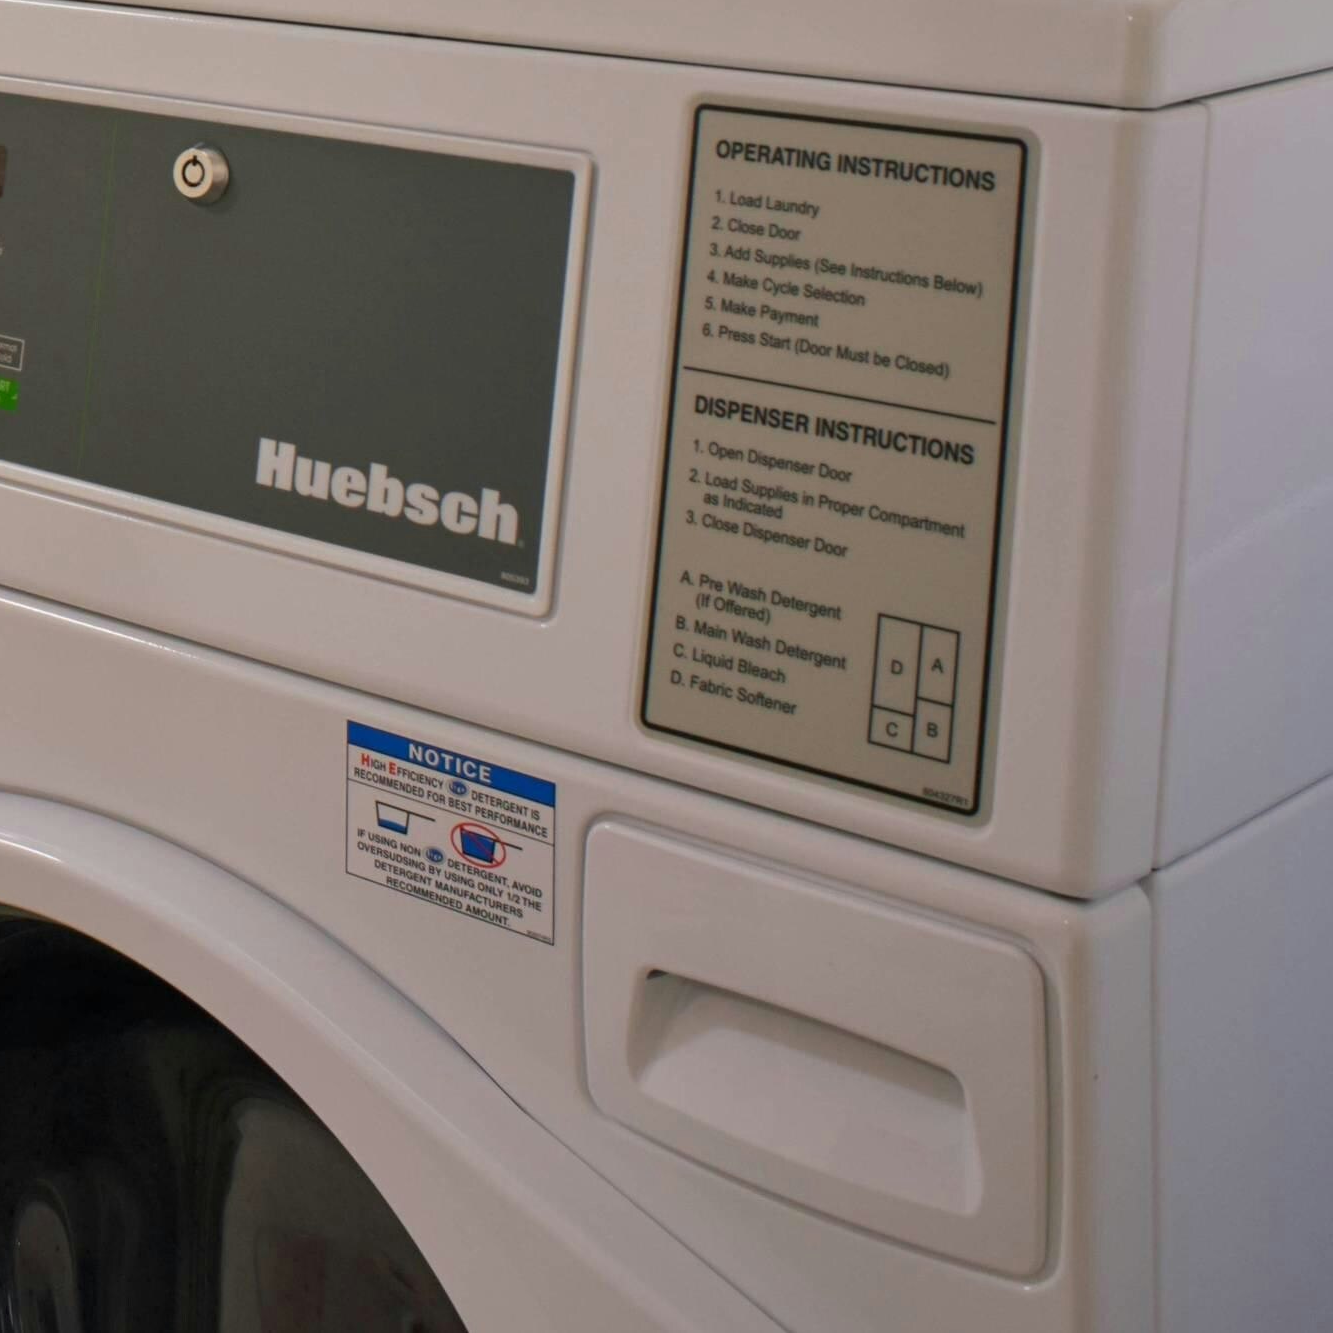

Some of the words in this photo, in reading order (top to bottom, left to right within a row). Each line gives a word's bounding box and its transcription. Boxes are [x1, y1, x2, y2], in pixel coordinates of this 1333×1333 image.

[716, 139, 831, 171] OPERATING
[837, 154, 995, 192] INSTRUCTIONS
[715, 189, 725, 203] 1.
[730, 191, 763, 209] Load
[765, 196, 820, 219] Laundry
[711, 215, 723, 230] 2.
[727, 218, 765, 236] Close
[768, 223, 801, 241] Door
[707, 269, 718, 283] 4.
[723, 271, 759, 290] Make
[762, 277, 800, 297] Cycle
[803, 283, 865, 306] Selection
[709, 242, 720, 256] 3.
[723, 245, 751, 261] Add
[754, 248, 811, 270] Supplies
[814, 258, 846, 276] (See
[850, 263, 930, 289] Instructions
[933, 274, 983, 299] Below)
[704, 296, 716, 310] 5.
[720, 298, 756, 317] Make
[760, 304, 819, 328] Payment
[702, 322, 714, 338] 6.
[718, 325, 756, 344] Press
[759, 332, 791, 350] Start
[794, 338, 833, 357] (Door
[836, 344, 870, 364] Must
[873, 351, 891, 368] be
[894, 354, 950, 380] Closed)
[694, 394, 809, 434] DISPENSER
[815, 417, 974, 465] INSTRUCTIONS
[694, 439, 704, 453] 1.
[707, 441, 744, 461] Open
[747, 449, 816, 475] Dispenser
[818, 462, 853, 482] Door
[256, 437, 519, 545] Huebsch
[689, 468, 700, 483] 2.
[705, 472, 738, 491] Load
[741, 478, 799, 504] Supplies
[802, 490, 815, 506] in
[818, 494, 865, 517] Proper
[868, 504, 965, 539] Compartment
[703, 493, 719, 506] as
[723, 494, 783, 519] Indicated
[686, 509, 697, 525] 3.
[701, 513, 739, 534] Close
[742, 521, 811, 549] Dispenser
[814, 537, 848, 557] Door
[680, 570, 693, 585] A.
[699, 573, 723, 592] Pre
[727, 580, 767, 602] Wash
[770, 590, 842, 621] Detergent
[695, 593, 711, 609] (If
[714, 596, 771, 625] Offered)
[673, 642, 687, 659] C.
[692, 648, 734, 671] Liquid
[737, 658, 786, 683] Bleach
[675, 615, 689, 631] B.
[694, 619, 727, 640] Main
[731, 628, 771, 651] Wash
[775, 639, 846, 670] Detergent
[890, 659, 904, 675] D
[931, 658, 944, 674] A
[670, 669, 685, 686] D.
[690, 674, 733, 699] Fabric
[736, 686, 797, 715] Softener
[885, 721, 899, 738] C
[926, 722, 938, 738] B
[361, 753, 386, 772] HIGH
[388, 761, 443, 789] EFFICIENCY
[409, 743, 491, 783] NOTICE
[354, 767, 424, 798] RECOMMENDED
[427, 790, 446, 805] FOR
[448, 797, 472, 813] BEST
[475, 805, 547, 838] PERFORMANCE
[471, 790, 528, 816] DETERGENT
[530, 808, 541, 822] IS
[356, 828, 366, 838] IF
[368, 832, 398, 849] USING
[400, 842, 421, 857] NON
[357, 841, 426, 872] OVERSUDSING
[428, 865, 441, 876] BY
[444, 870, 475, 888] USING
[477, 882, 504, 898] ONLY
[507, 892, 520, 904] 1/2
[522, 896, 541, 912] THE
[374, 859, 432, 886] DETERGENT
[435, 880, 523, 918] MANUFACTURERS
[386, 876, 463, 909] RECOMMENDED
[512, 881, 542, 898] AVOID
